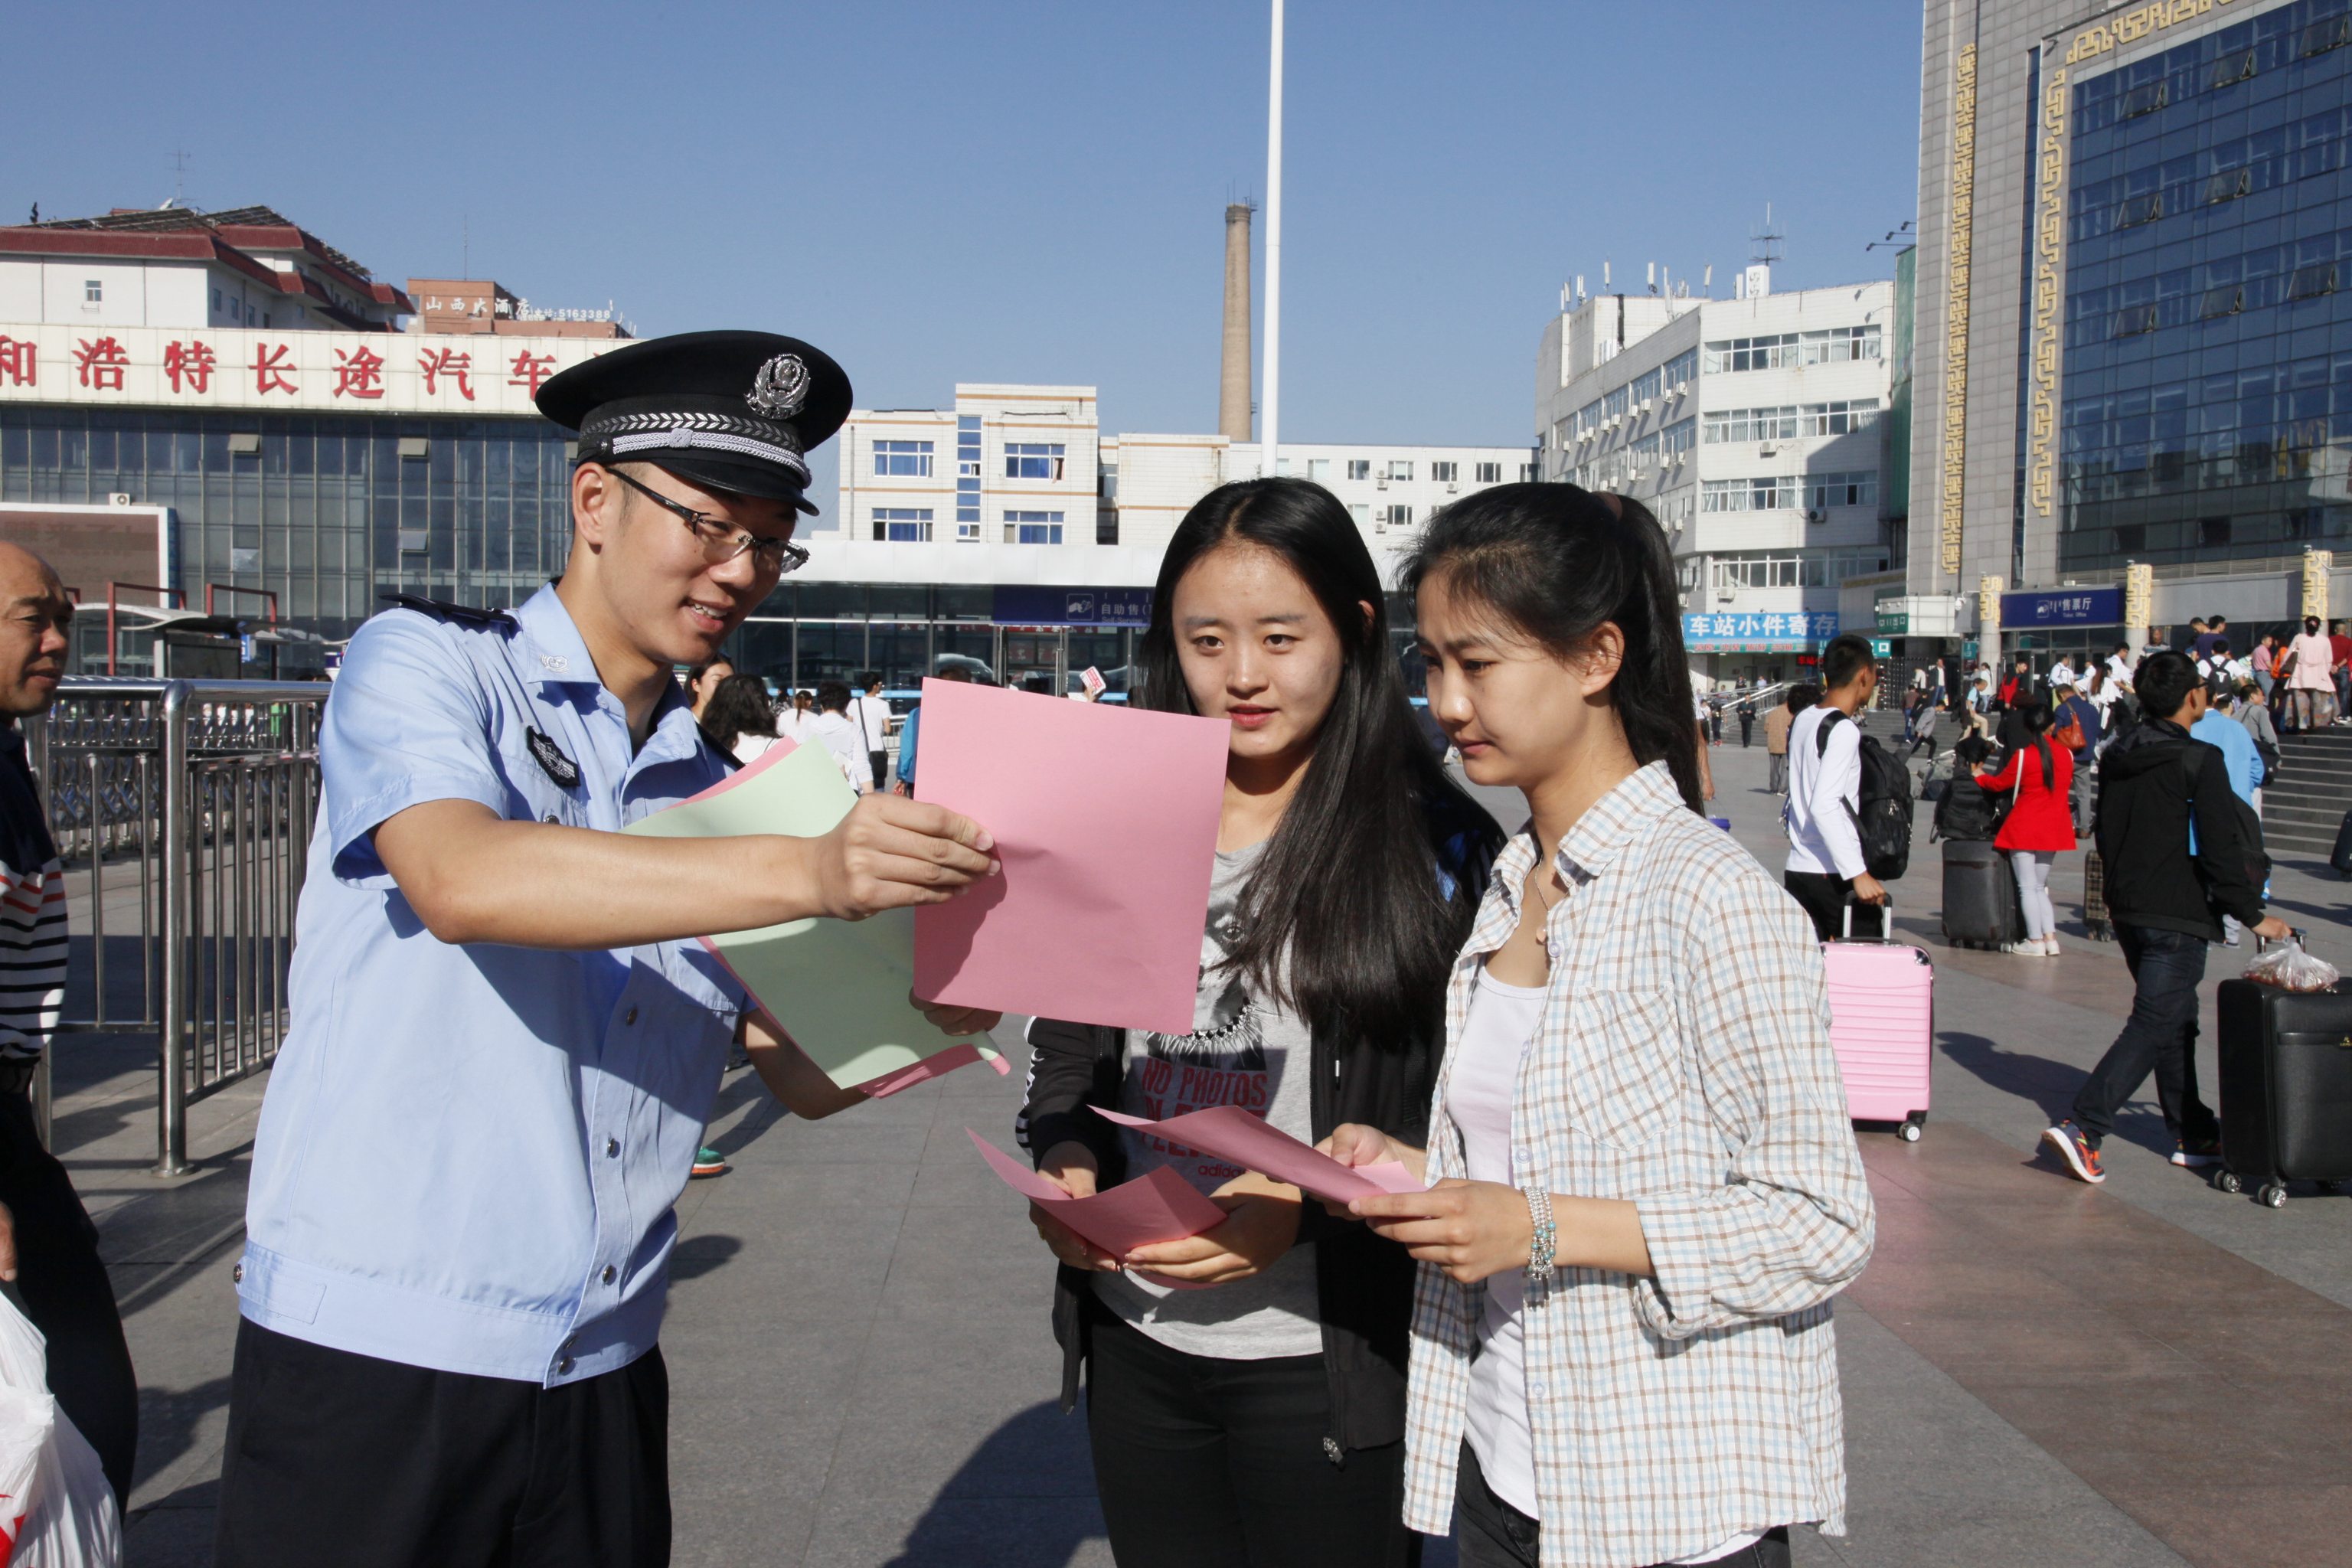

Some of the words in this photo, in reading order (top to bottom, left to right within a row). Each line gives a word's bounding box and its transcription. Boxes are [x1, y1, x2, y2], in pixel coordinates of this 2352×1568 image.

[426, 296, 531, 319] 山西大酒店
[0, 335, 601, 402] 和浩特长途汽车
[2063, 597, 2092, 611] 售票厅
[1689, 614, 1837, 637] 车站小件寄存
[1142, 1057, 1174, 1095] NO
[1177, 1067, 1269, 1107] PHOTOS
